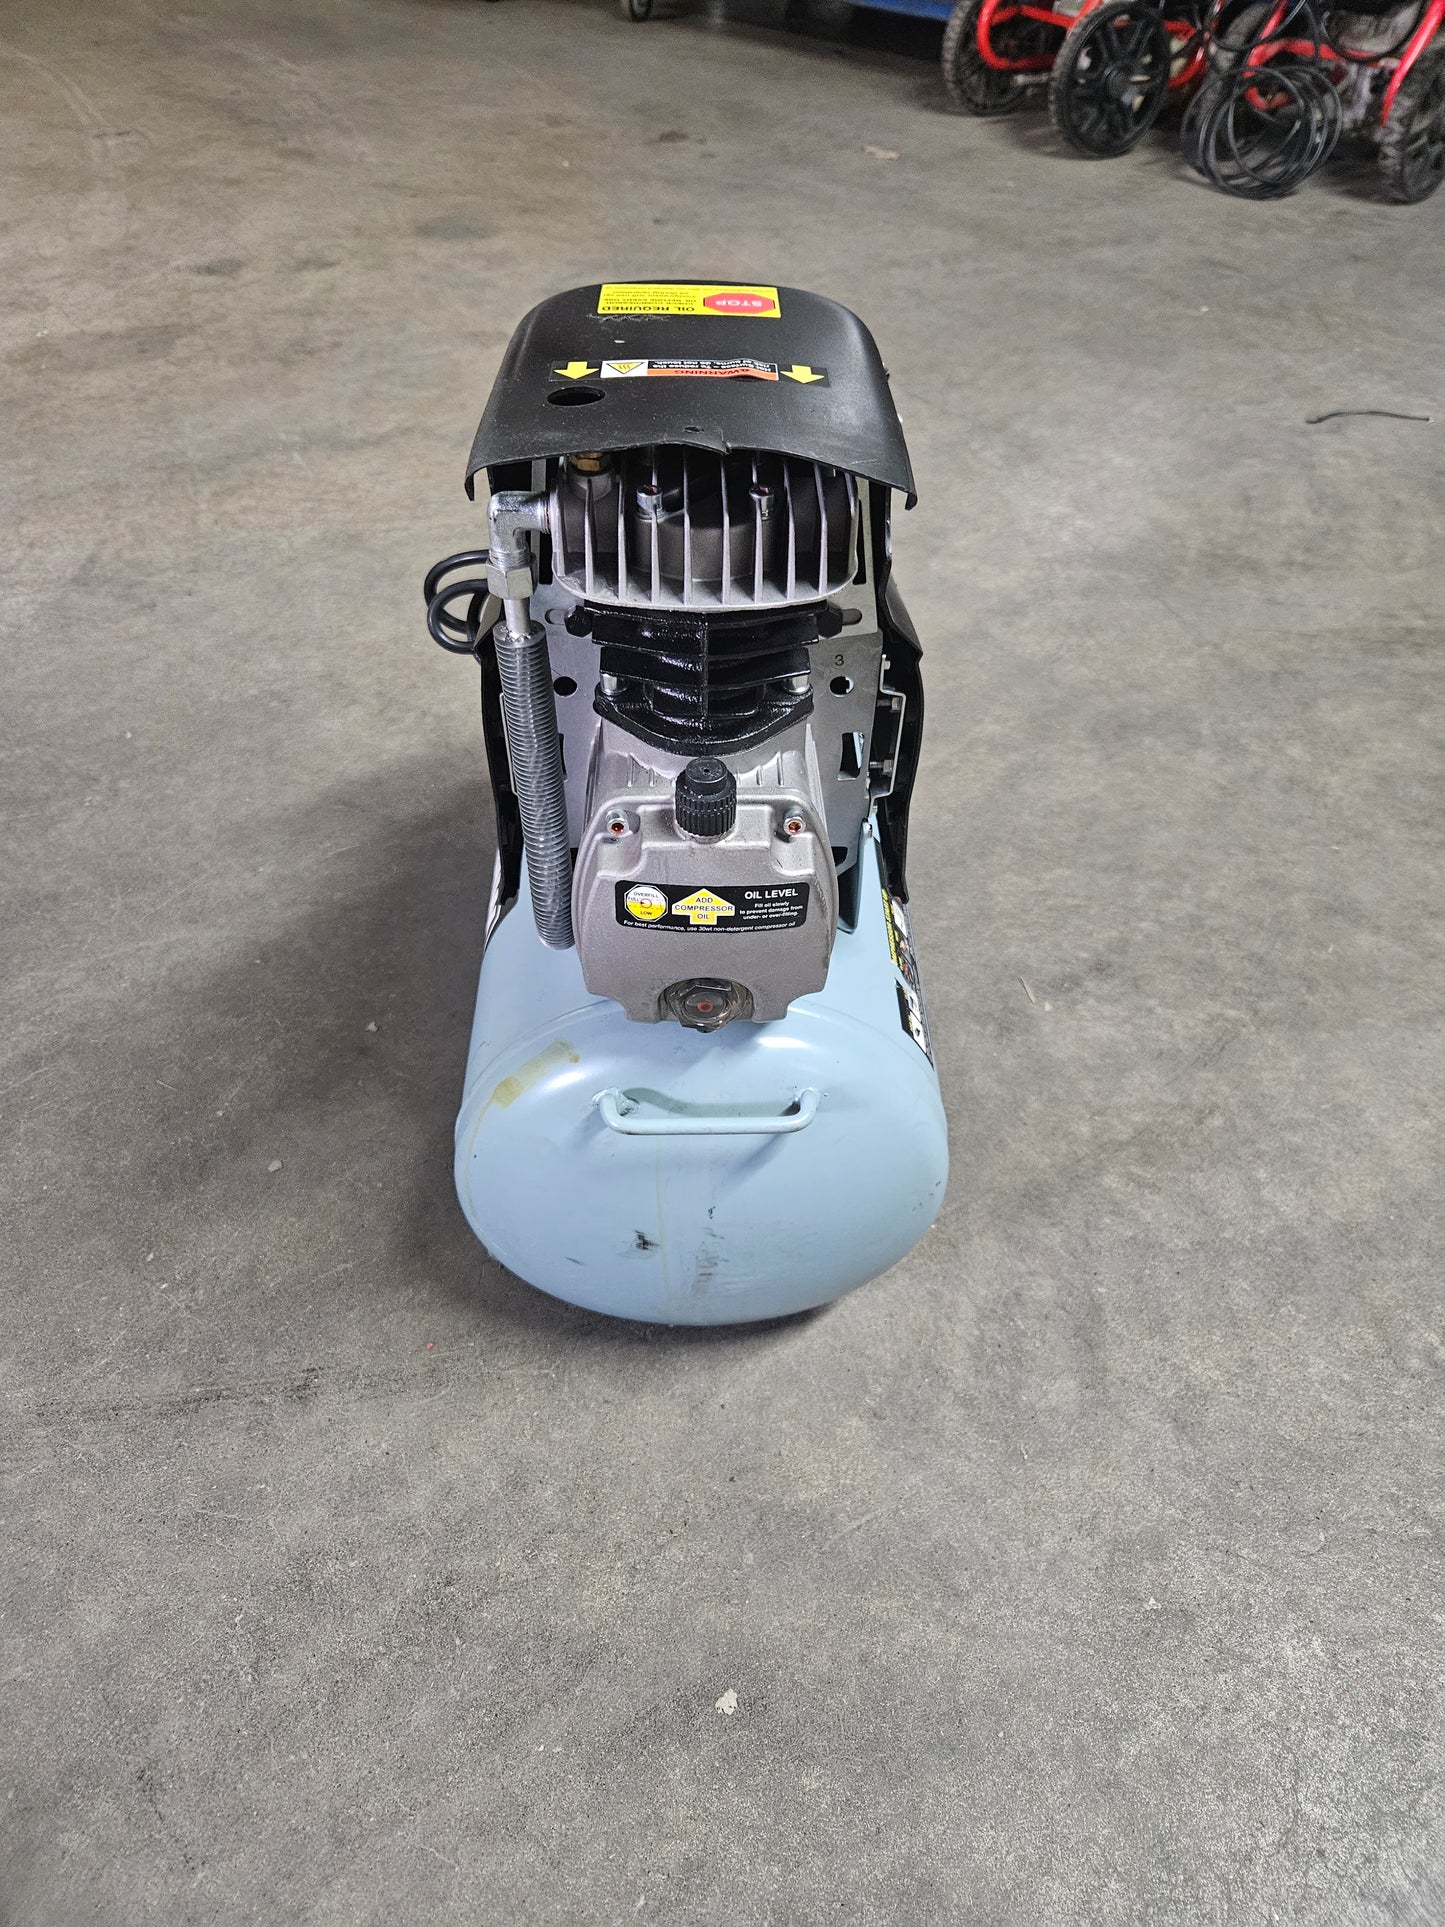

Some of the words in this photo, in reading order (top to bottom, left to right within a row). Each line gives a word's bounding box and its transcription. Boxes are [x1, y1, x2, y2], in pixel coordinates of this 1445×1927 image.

[715, 299, 763, 308] STOP
[834, 654, 845, 666] 3
[744, 890, 763, 899] OIL
[765, 888, 799, 899] LEVEL
[674, 904, 734, 912] COMPRESSOR
[648, 923, 686, 932] performance,
[754, 923, 788, 931] compressor
